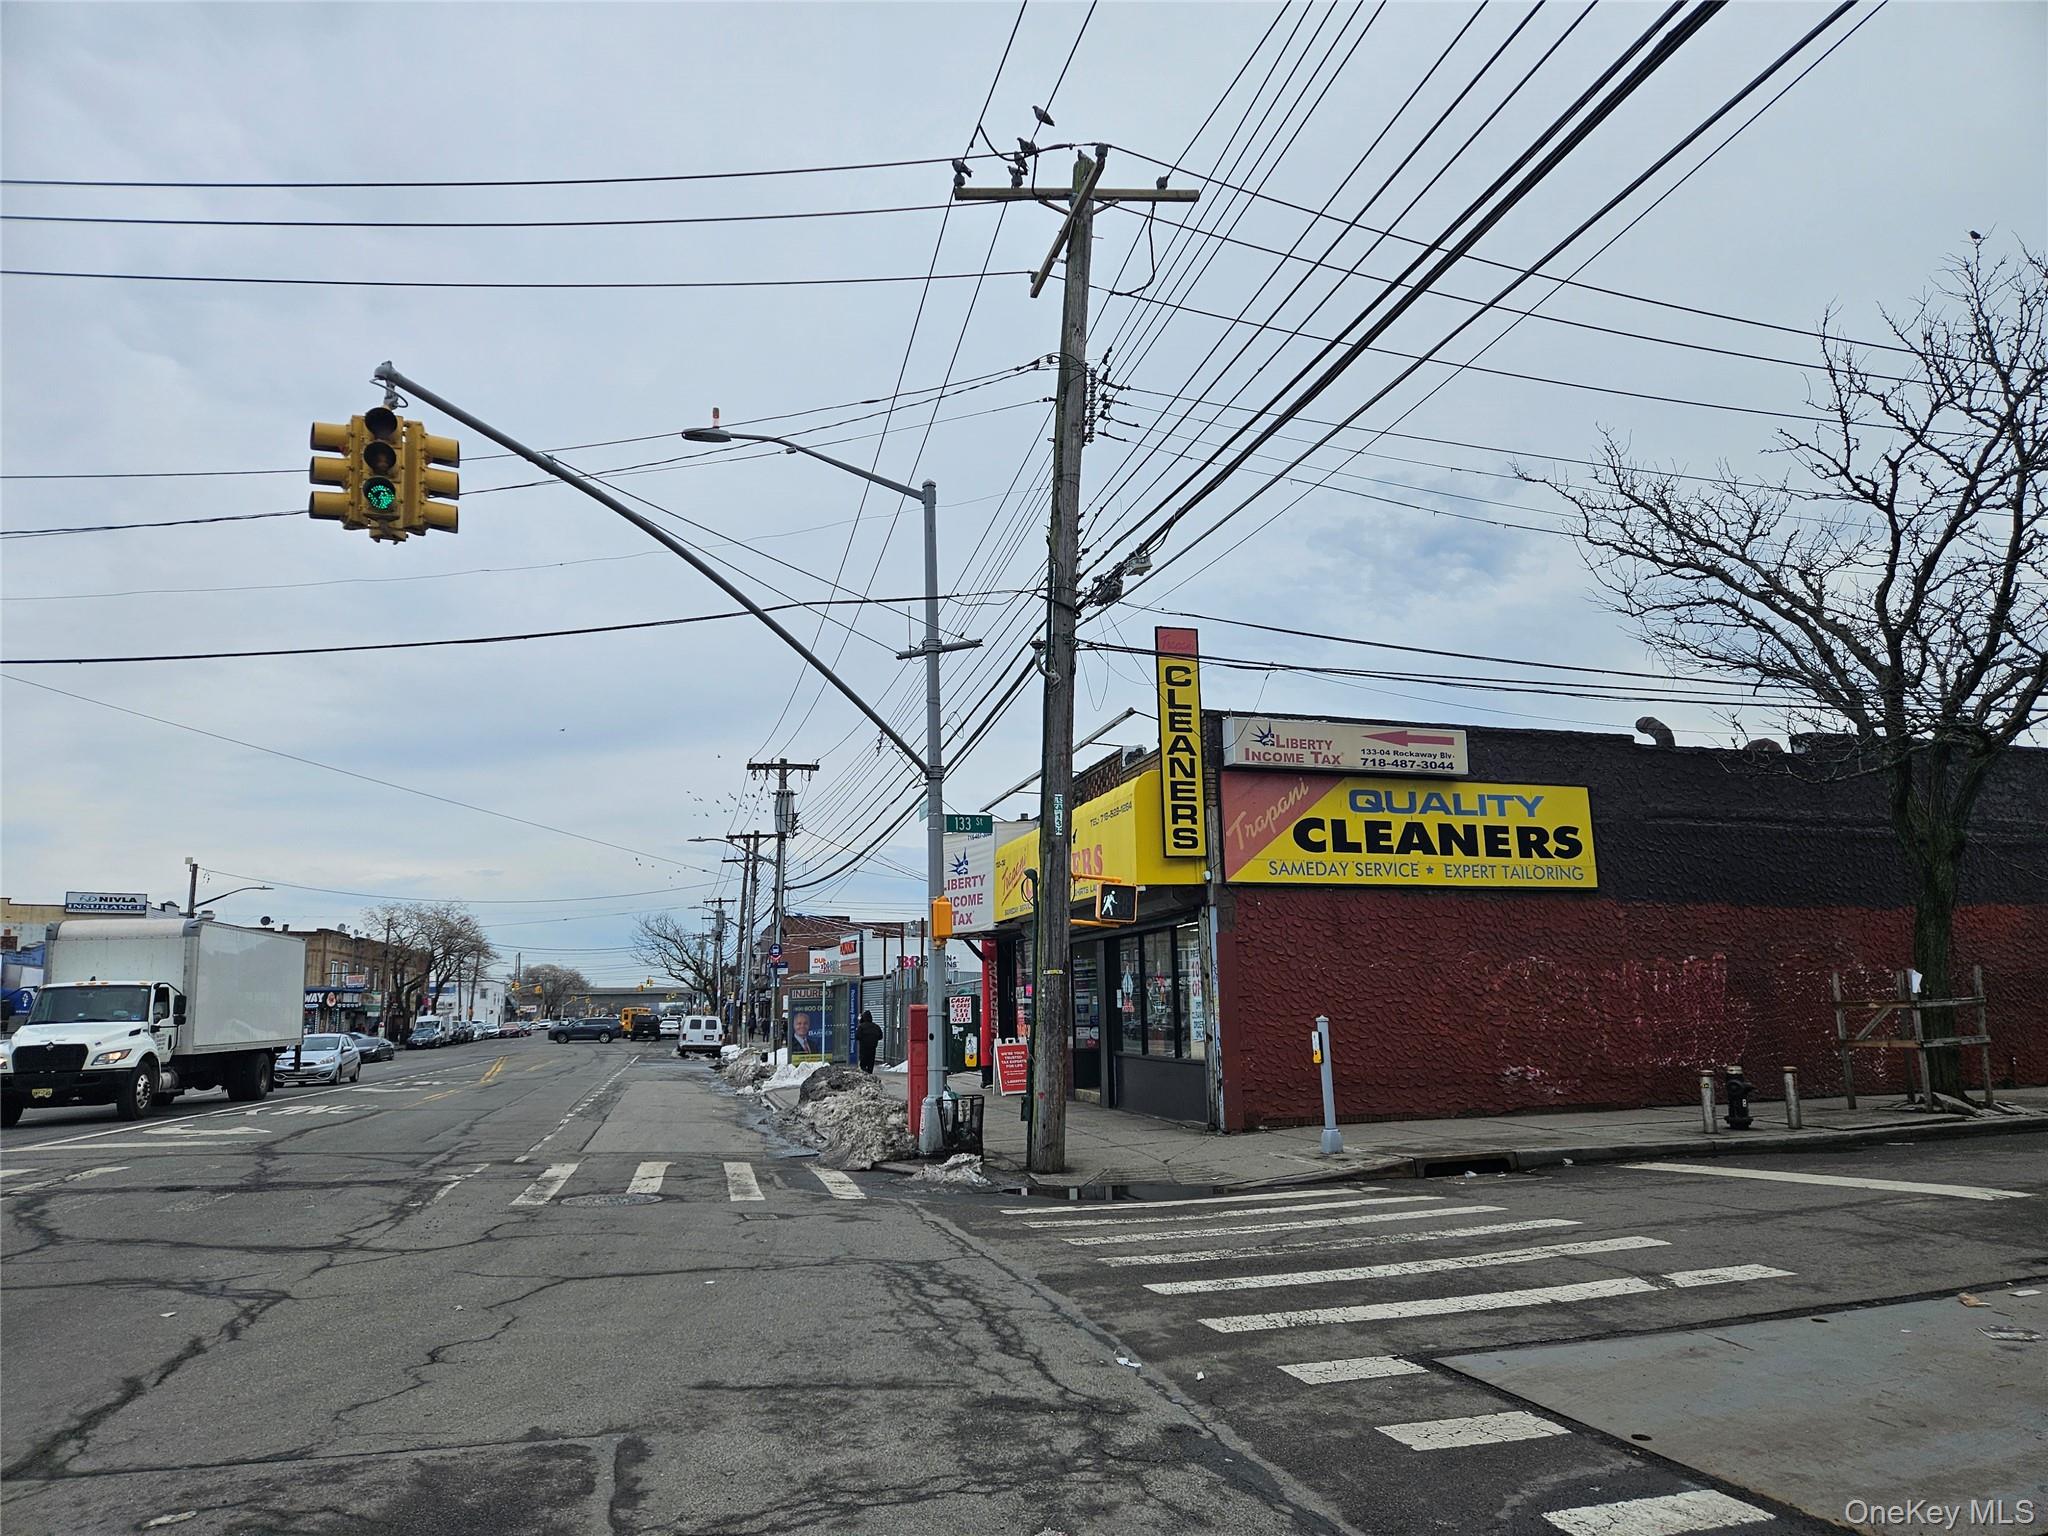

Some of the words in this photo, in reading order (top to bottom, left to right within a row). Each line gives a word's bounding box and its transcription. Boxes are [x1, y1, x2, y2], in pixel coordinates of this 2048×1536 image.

[1275, 734, 1333, 751] LIBERTY
[1165, 665, 1199, 849] CLEANERS
[1244, 747, 1304, 764] INCOME
[1310, 750, 1341, 765] TAX
[1360, 748, 1390, 757] 133-04
[1392, 749, 1437, 759] Rockaway
[1360, 758, 1455, 770] 718-487-3044
[1349, 789, 1545, 818] QUALITY
[1226, 777, 1309, 850] Trapani
[954, 816, 972, 831] 133
[975, 816, 983, 826] St
[1292, 817, 1583, 859] CLEANERS
[1268, 860, 1347, 877] SAMEDAY
[1354, 861, 1419, 878] SERVICE
[1444, 863, 1496, 880] EXPERT
[1502, 864, 1585, 881] TAILORING
[944, 874, 986, 891] IBERTY
[951, 910, 973, 926] TAX
